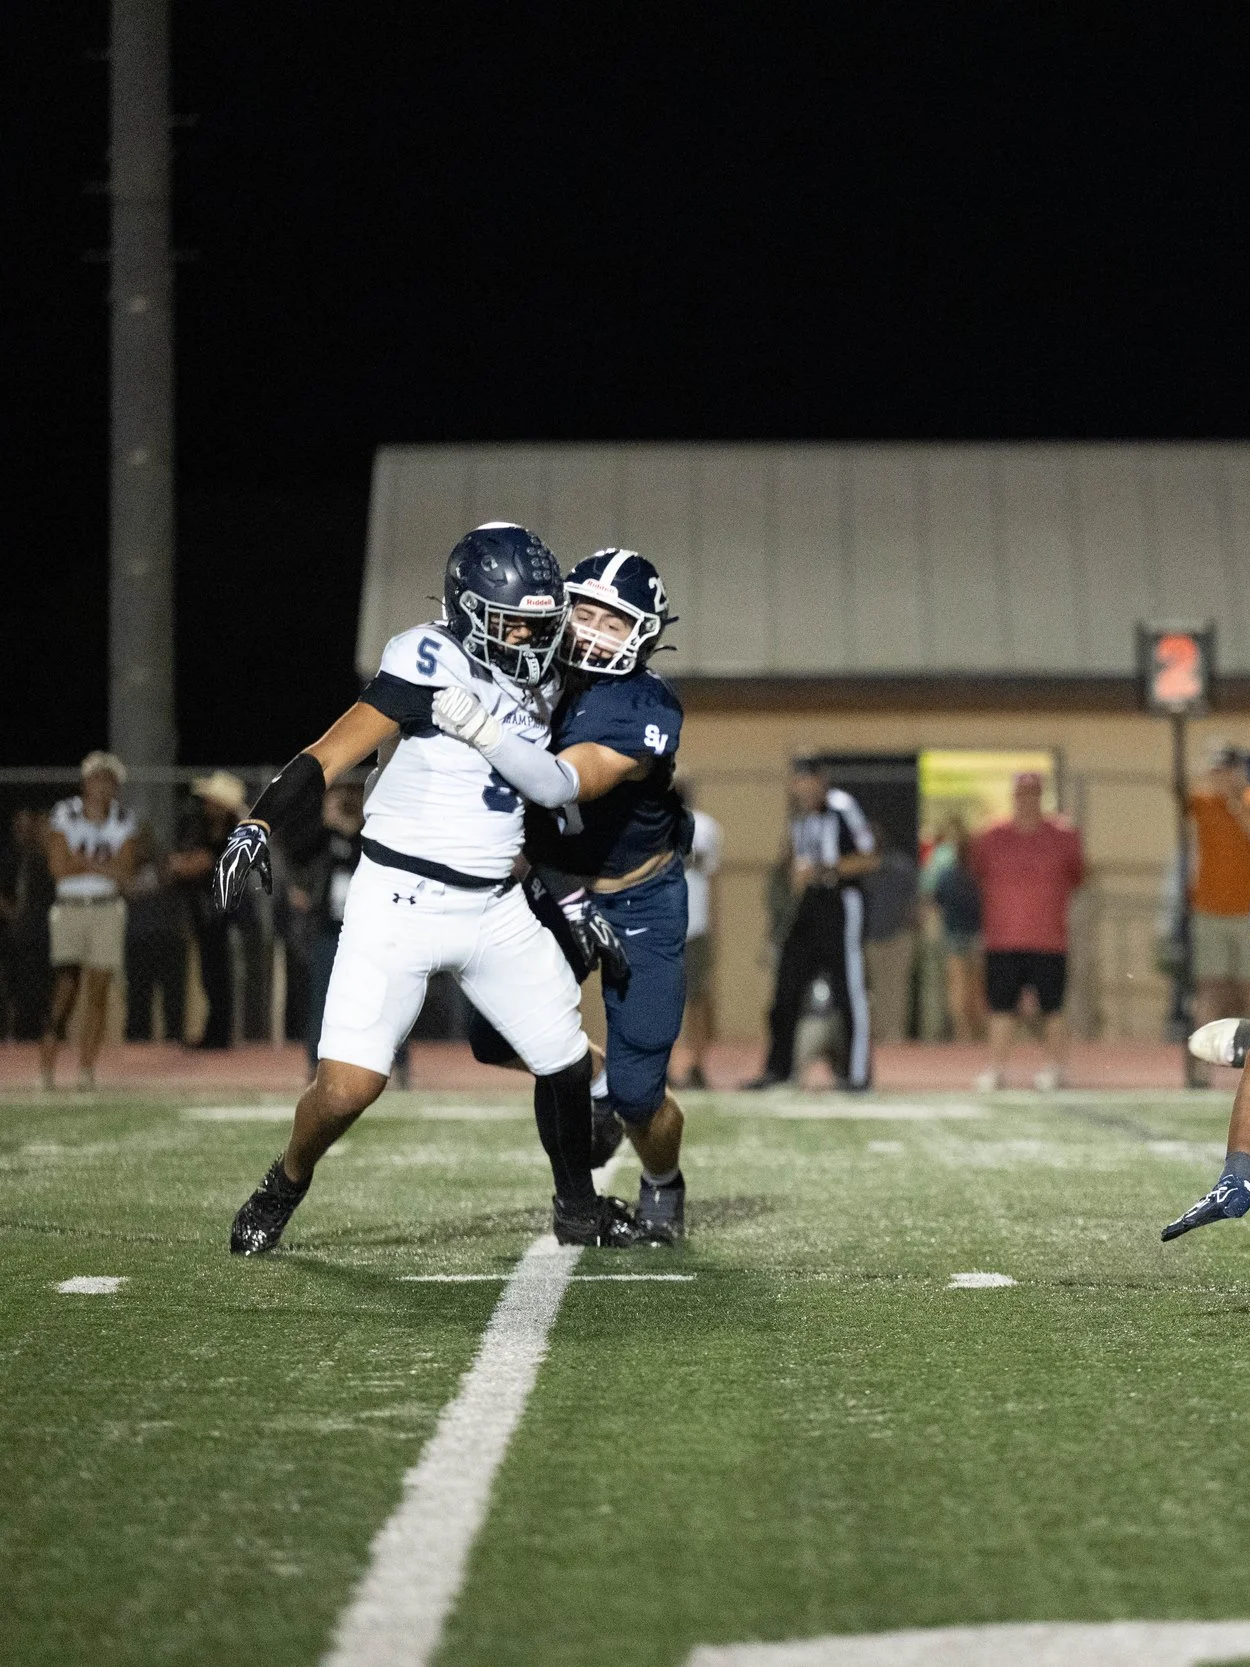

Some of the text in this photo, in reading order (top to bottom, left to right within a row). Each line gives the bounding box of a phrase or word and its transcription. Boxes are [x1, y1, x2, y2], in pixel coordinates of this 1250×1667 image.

[415, 636, 443, 677] 5
[1156, 634, 1201, 700] 2
[643, 723, 669, 755] SV
